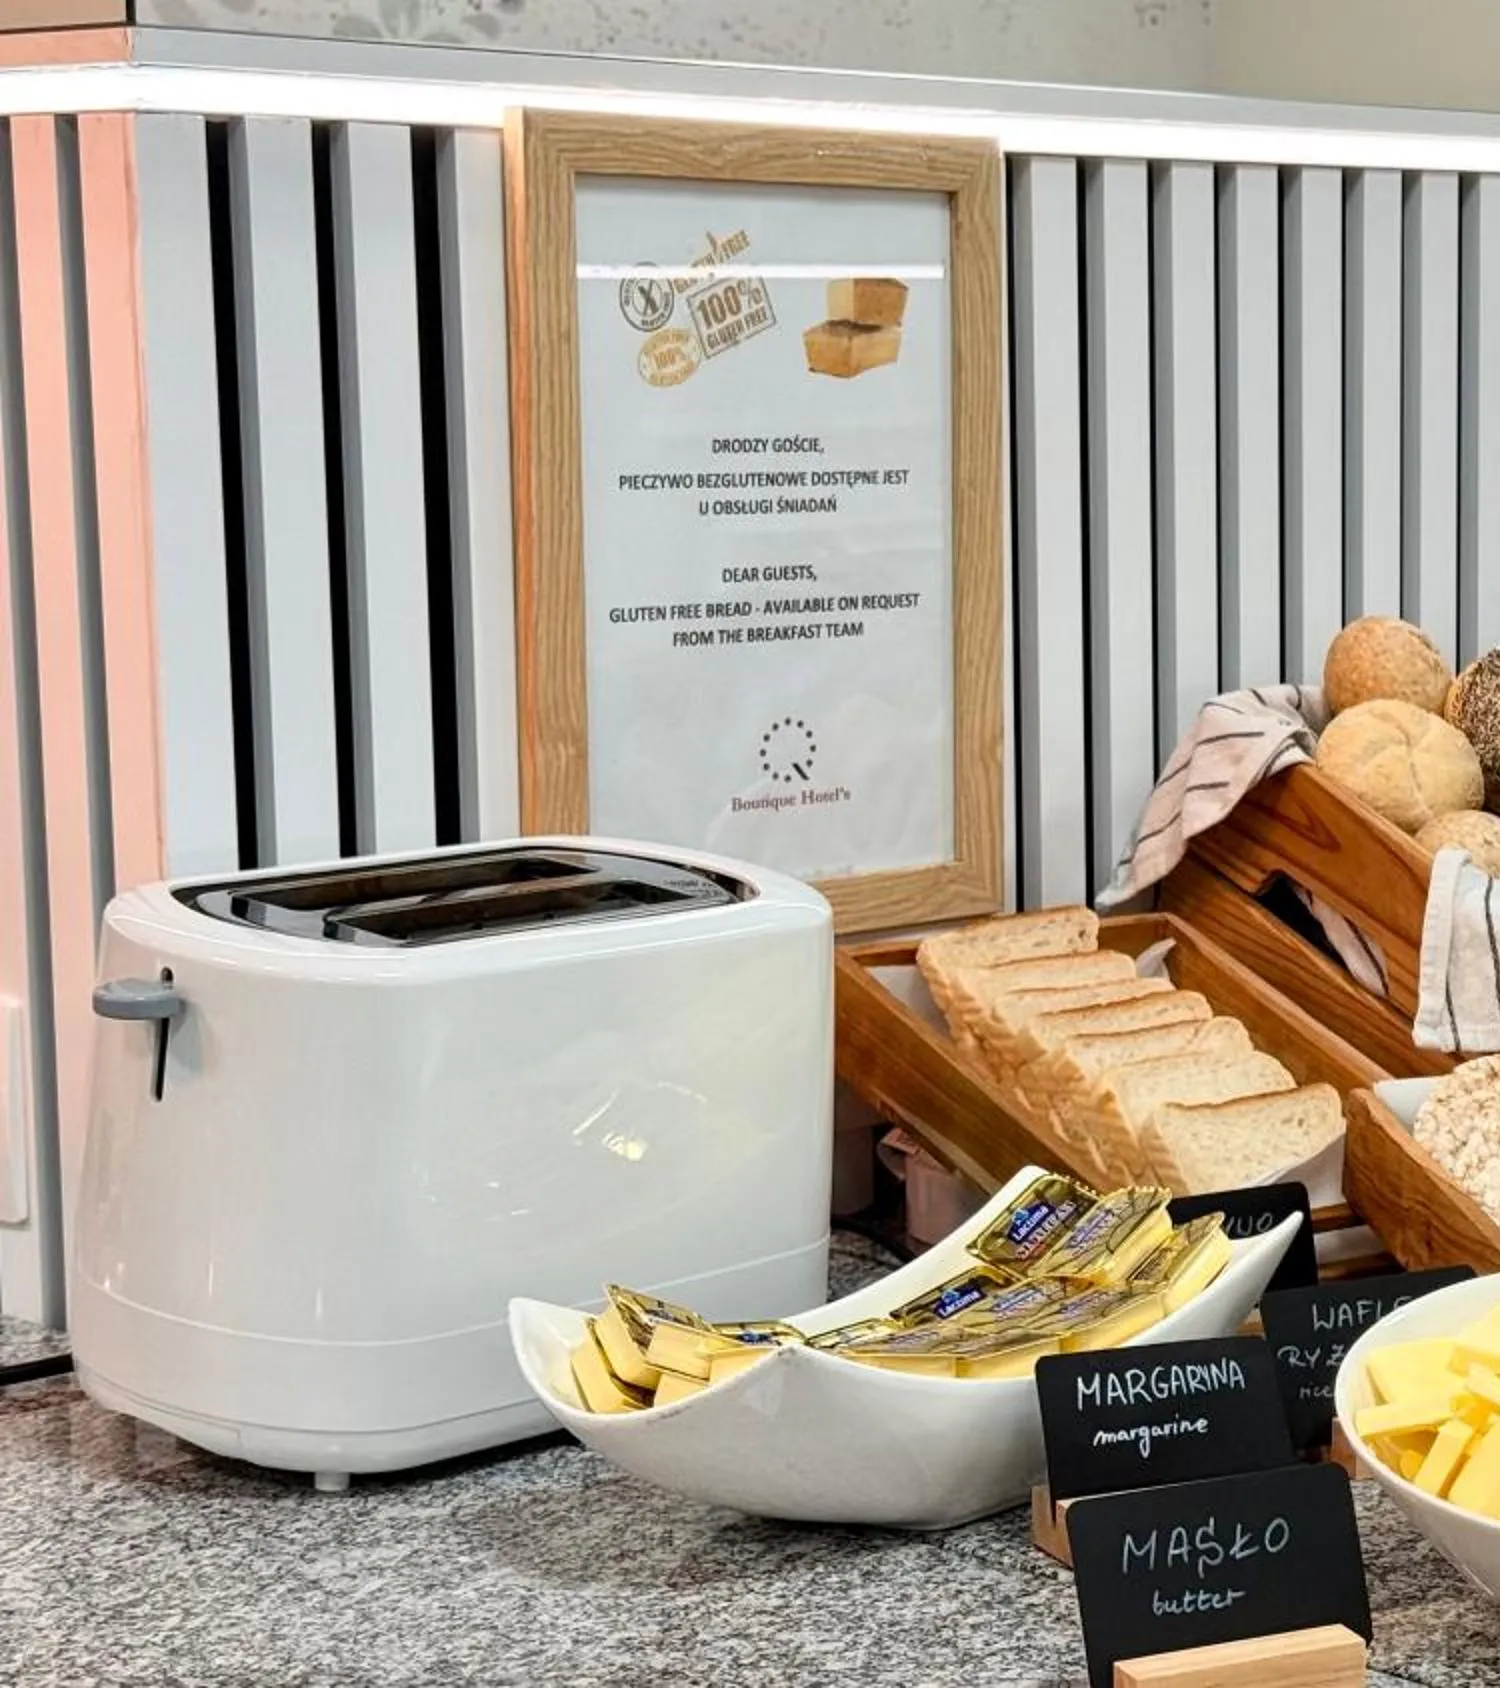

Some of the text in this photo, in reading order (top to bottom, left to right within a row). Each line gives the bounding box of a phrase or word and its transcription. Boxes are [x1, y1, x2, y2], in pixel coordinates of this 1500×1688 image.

[696, 277, 764, 330] 100%
[744, 306, 768, 331] FREE
[712, 434, 825, 454] DRODZY GOŚCIE,
[619, 469, 910, 491] PIECZYWO BEZGLUTENOWE DOSTĘPNE JEST
[699, 494, 837, 516] U OBSŁUGI ŚNIADAŃ
[722, 565, 818, 583] DEAR GUESTS,
[609, 606, 667, 624] GLUTEN
[670, 603, 703, 620] FREE
[706, 601, 753, 619] BREAD
[763, 597, 835, 616] AVAILABLE
[838, 595, 859, 611] ON
[861, 592, 921, 611] REQUEST
[672, 621, 865, 648] FROM THE BREAKFAST TEAM
[731, 786, 851, 813] Boutique Hotel's
[1076, 1356, 1246, 1412] MARGARYNA
[1092, 1412, 1209, 1459] margarine
[1152, 1588, 1246, 1616] butter
